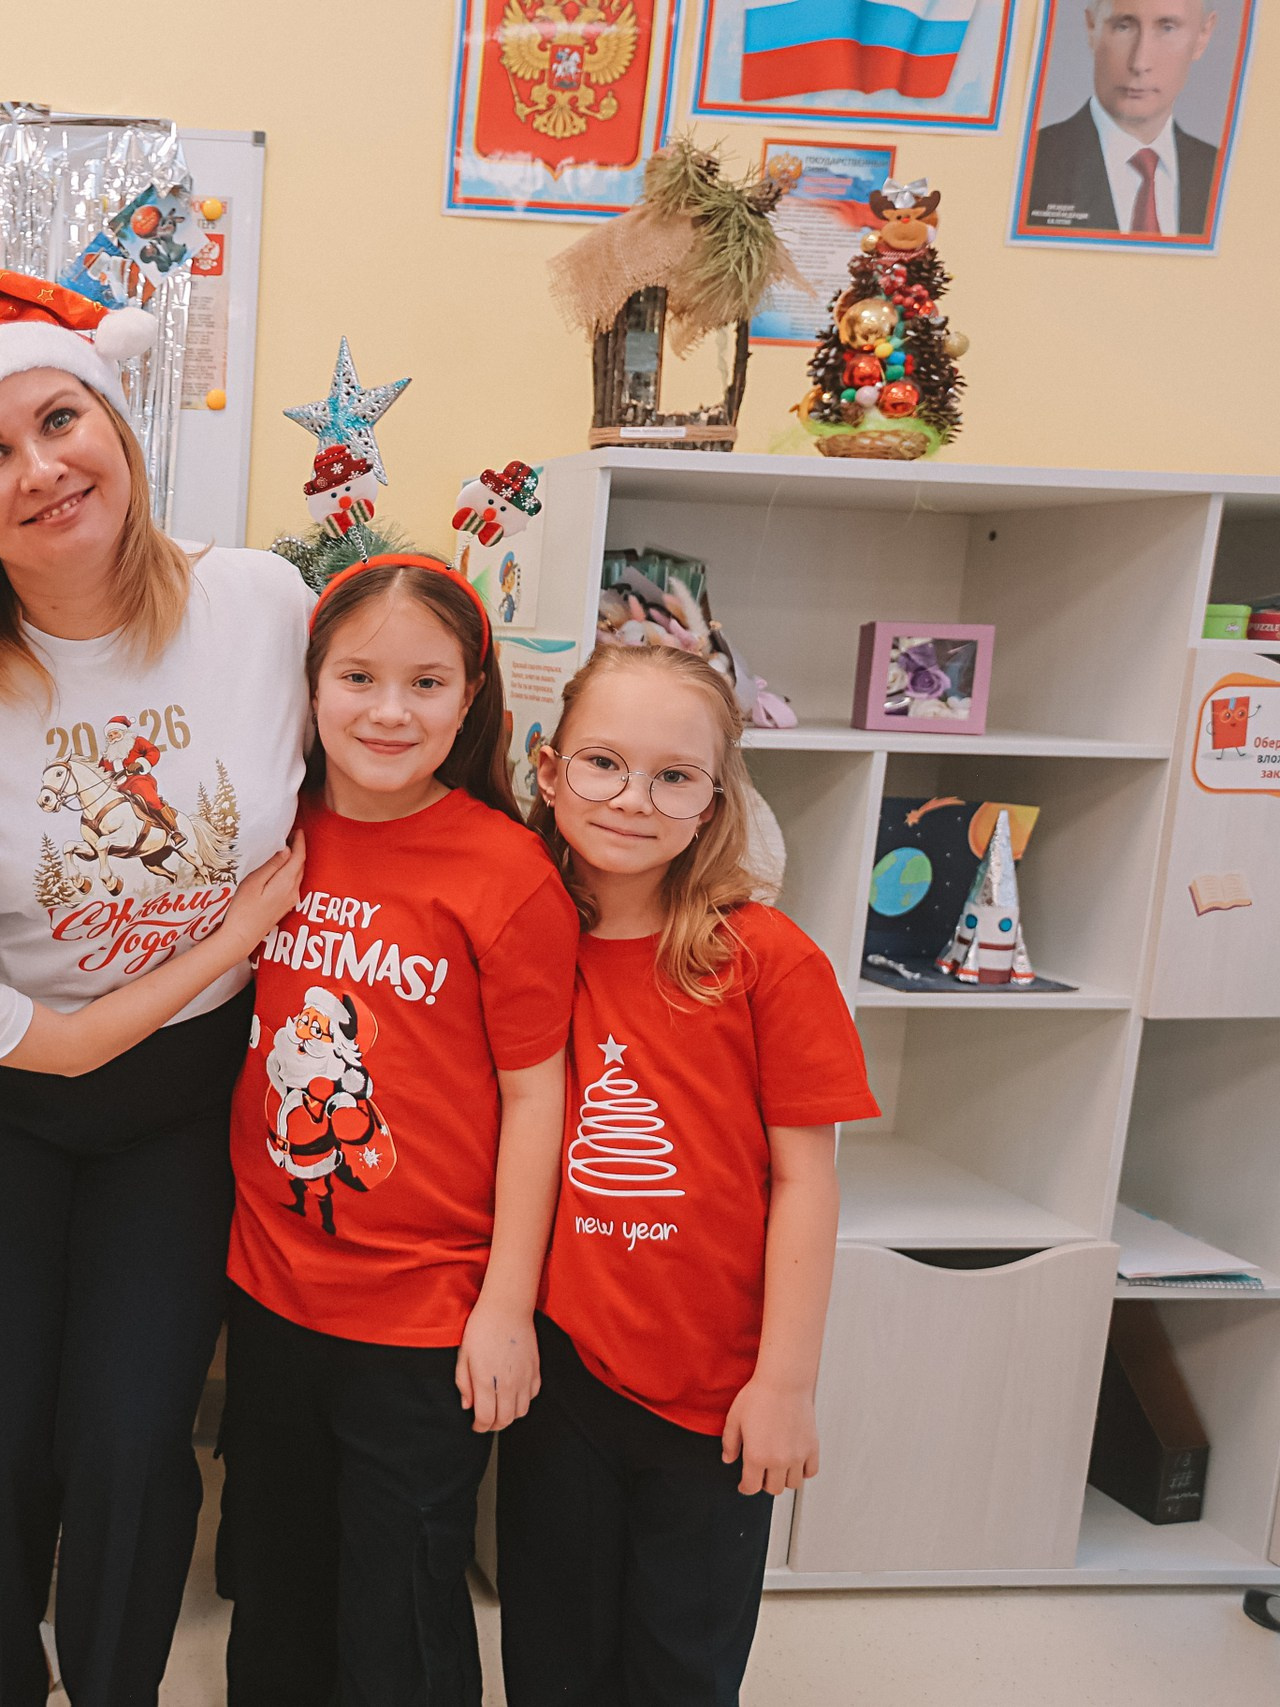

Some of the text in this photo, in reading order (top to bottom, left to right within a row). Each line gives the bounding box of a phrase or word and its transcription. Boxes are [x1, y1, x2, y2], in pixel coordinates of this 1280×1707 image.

[1257, 754, 1280, 763] вло
[575, 1216, 678, 1251] new year
